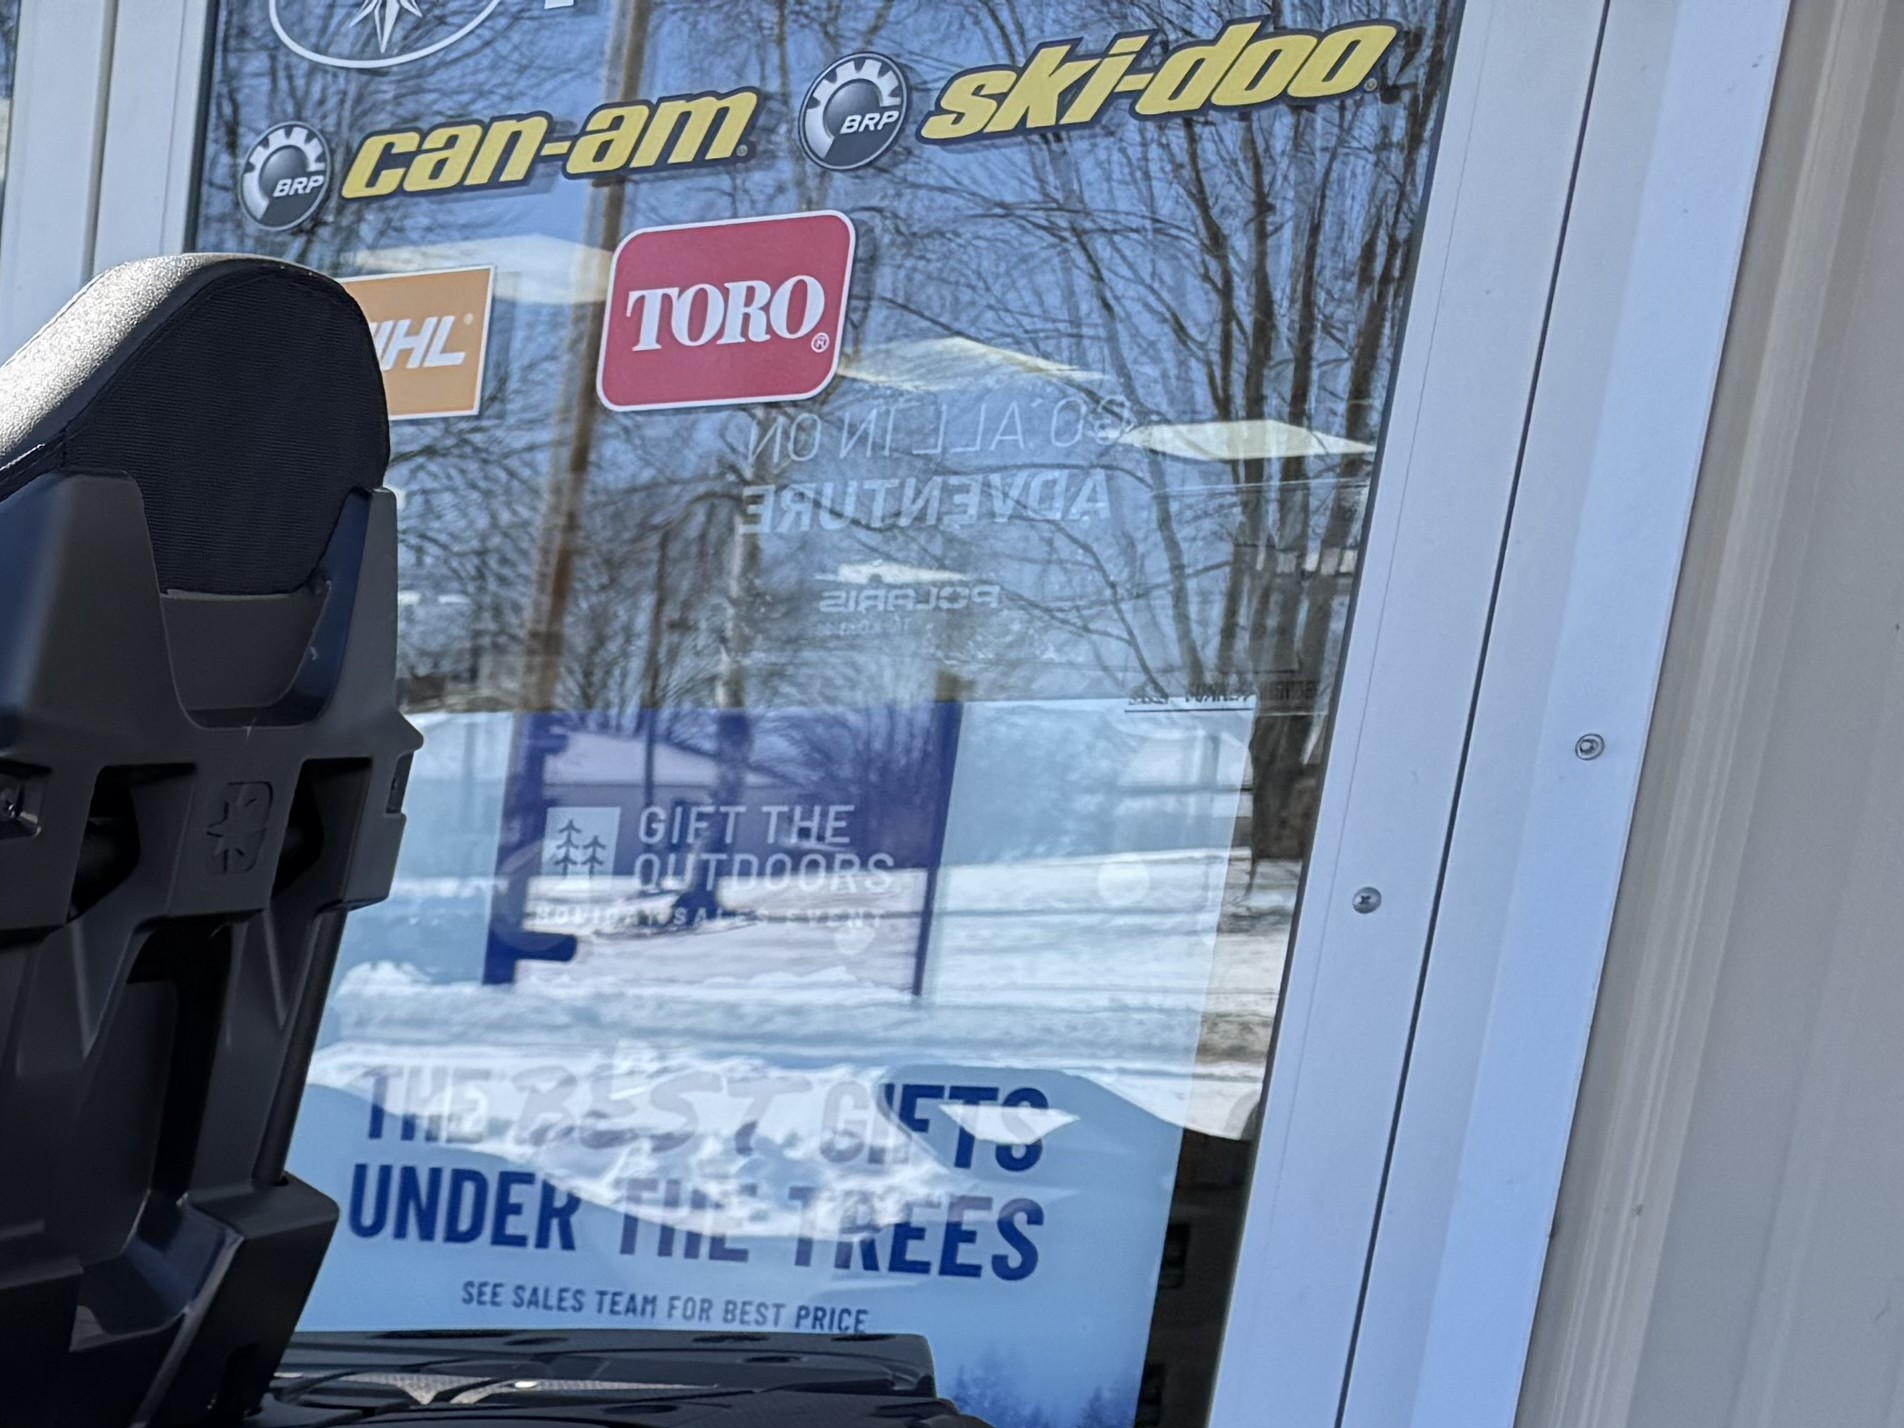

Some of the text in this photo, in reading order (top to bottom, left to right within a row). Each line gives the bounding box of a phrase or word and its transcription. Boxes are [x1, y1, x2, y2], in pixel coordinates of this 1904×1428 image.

[920, 20, 1399, 142] ski-doo
[342, 88, 759, 200] can-am
[840, 105, 903, 136] BRP
[273, 174, 327, 201] BRP
[626, 275, 826, 352] TORO
[638, 803, 856, 845] GIFT THE
[632, 852, 896, 894] OUTDOORS
[366, 1068, 492, 1142] THE
[819, 1080, 1049, 1172] GIFTS
[348, 1161, 1046, 1282] UNDER THE TREES
[461, 1280, 869, 1334] SEE SALES TEAM FOR BEST PRICE
